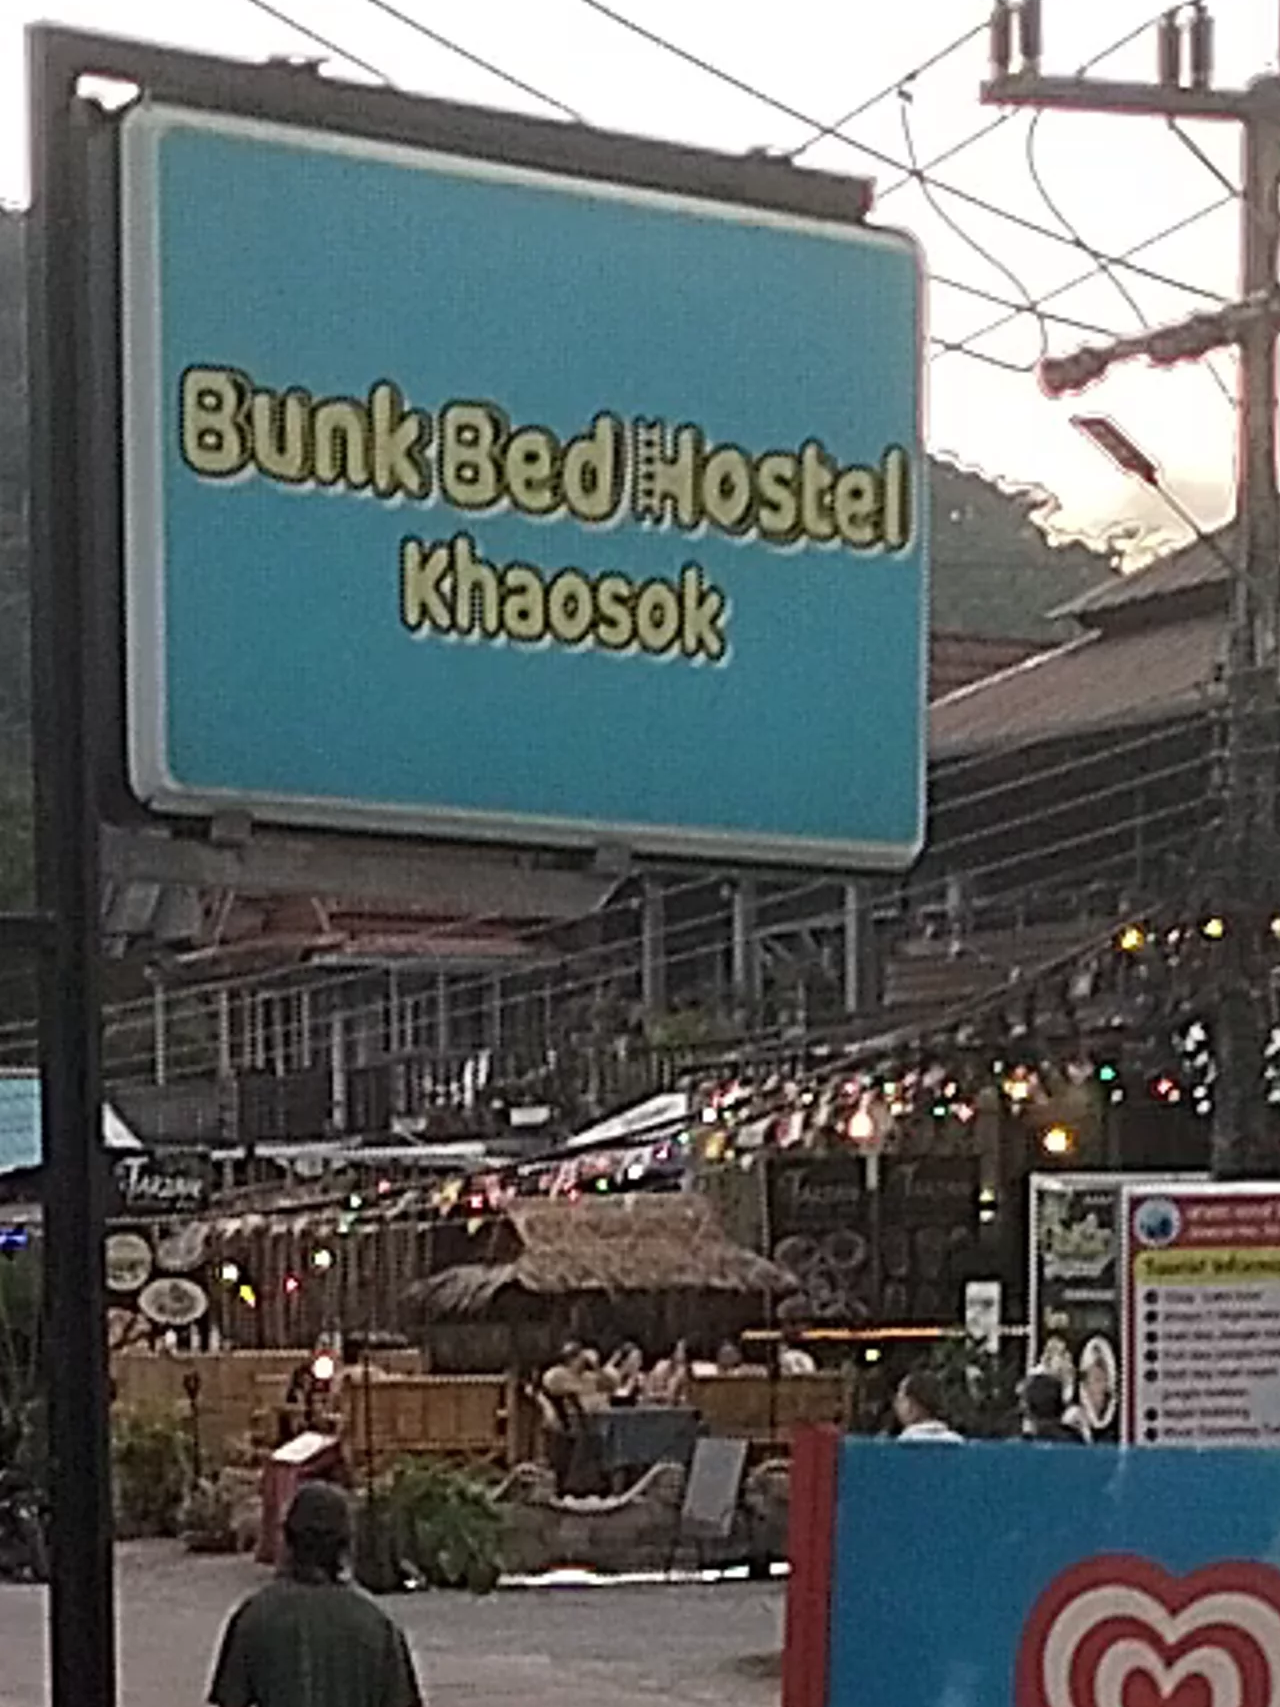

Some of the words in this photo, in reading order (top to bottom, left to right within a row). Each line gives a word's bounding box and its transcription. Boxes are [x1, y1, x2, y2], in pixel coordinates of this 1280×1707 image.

[179, 365, 433, 501] Bunk
[437, 400, 625, 525] Bed
[632, 415, 910, 551] Hostel
[400, 533, 726, 661] Khaosok
